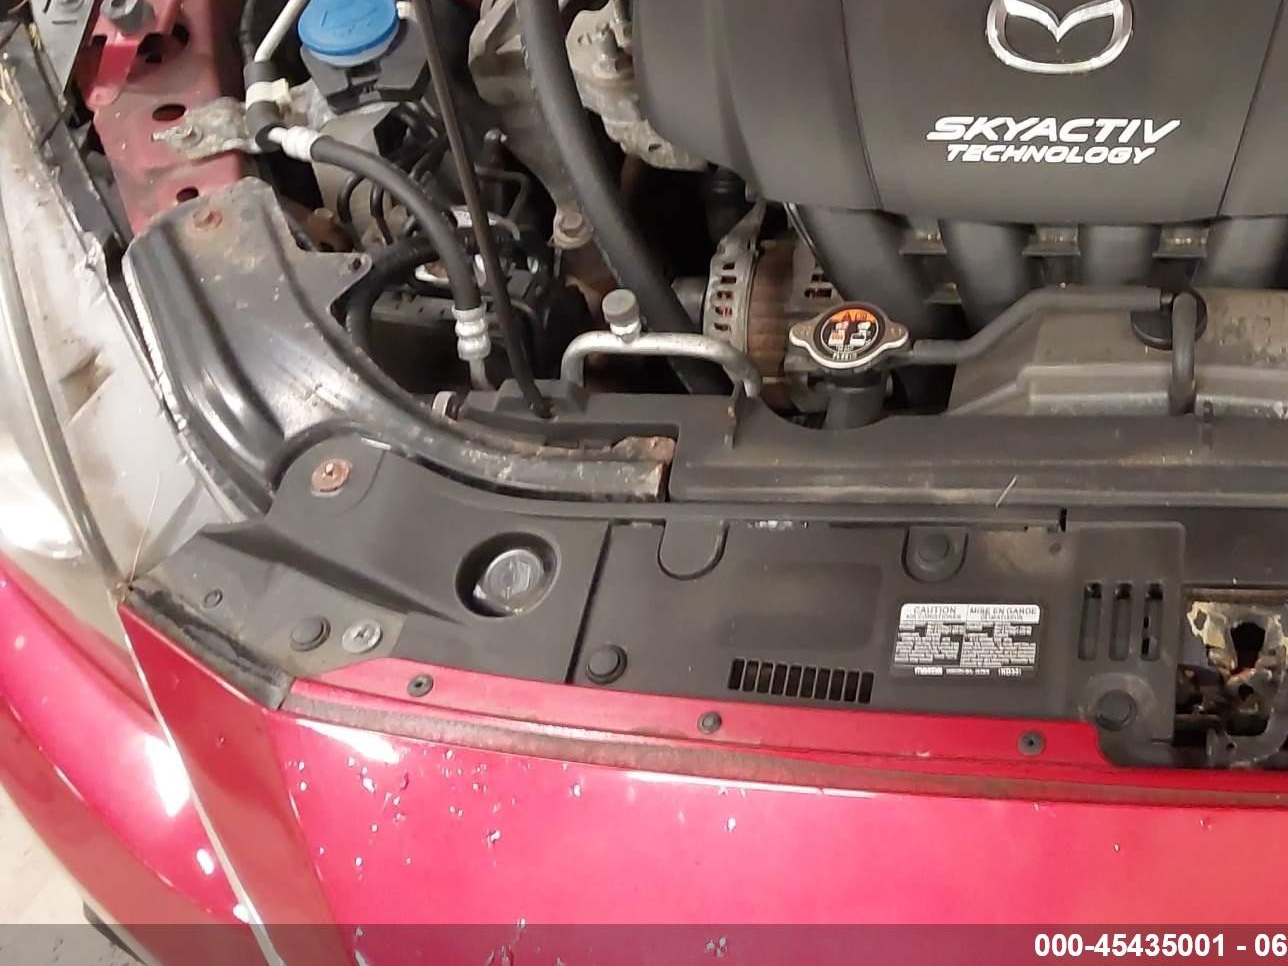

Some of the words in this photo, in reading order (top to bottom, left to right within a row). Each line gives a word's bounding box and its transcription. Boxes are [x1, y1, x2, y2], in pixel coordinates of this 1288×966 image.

[926, 116, 1181, 144] SKYACTIV
[947, 144, 1156, 165] TECHNOLOGY
[913, 605, 957, 614] CAUTION
